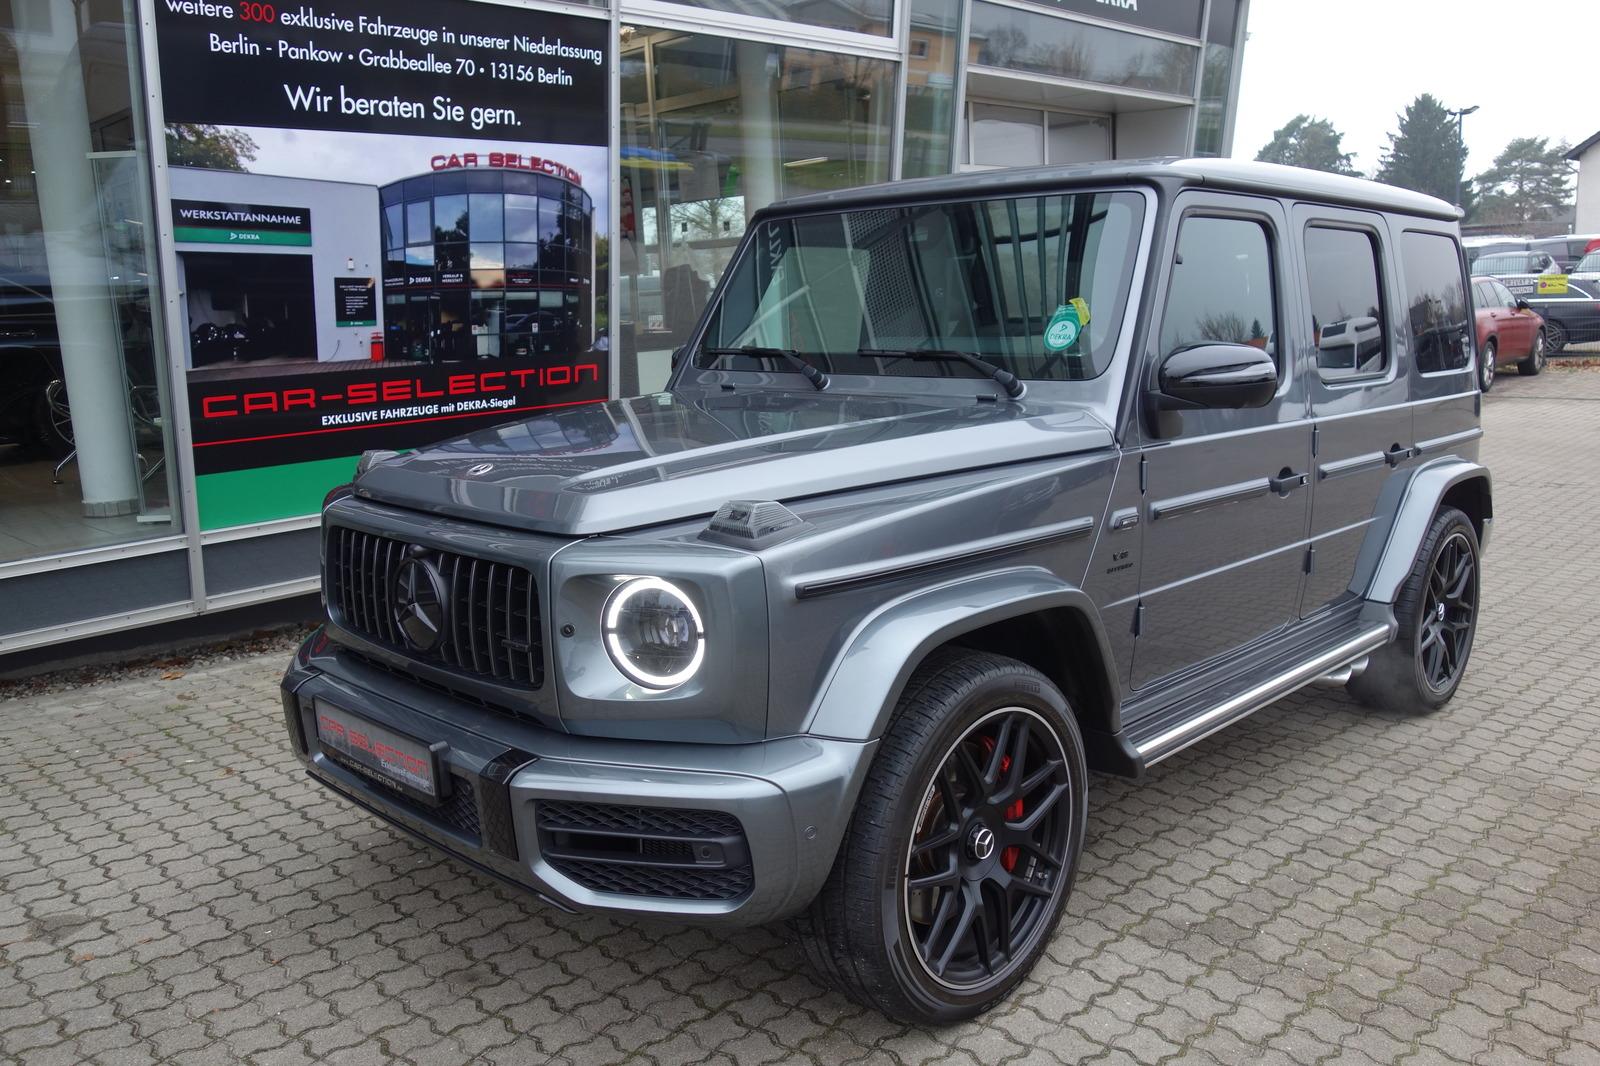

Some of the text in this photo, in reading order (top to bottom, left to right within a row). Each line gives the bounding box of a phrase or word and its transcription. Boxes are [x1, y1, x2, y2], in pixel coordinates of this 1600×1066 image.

[165, 0, 603, 66] weitere 300 exklusive Fahrzeuge in unserer Niederlassung
[209, 32, 260, 56] Berlin
[278, 39, 344, 63] Pankow
[358, 48, 453, 75] Grabbeallee
[455, 58, 476, 77] 70
[490, 62, 535, 83] 13156
[537, 66, 574, 86] Berlin
[283, 83, 522, 130] Wir beraten Sie gern.
[430, 152, 582, 185] CAR SELECTION
[179, 208, 302, 225] WERKSTATTANNAHME
[202, 363, 599, 419] CAR-SELECTION
[321, 395, 516, 426] EXKLUSIVE FAHRZEUGE mit DEKRA-Siegel
